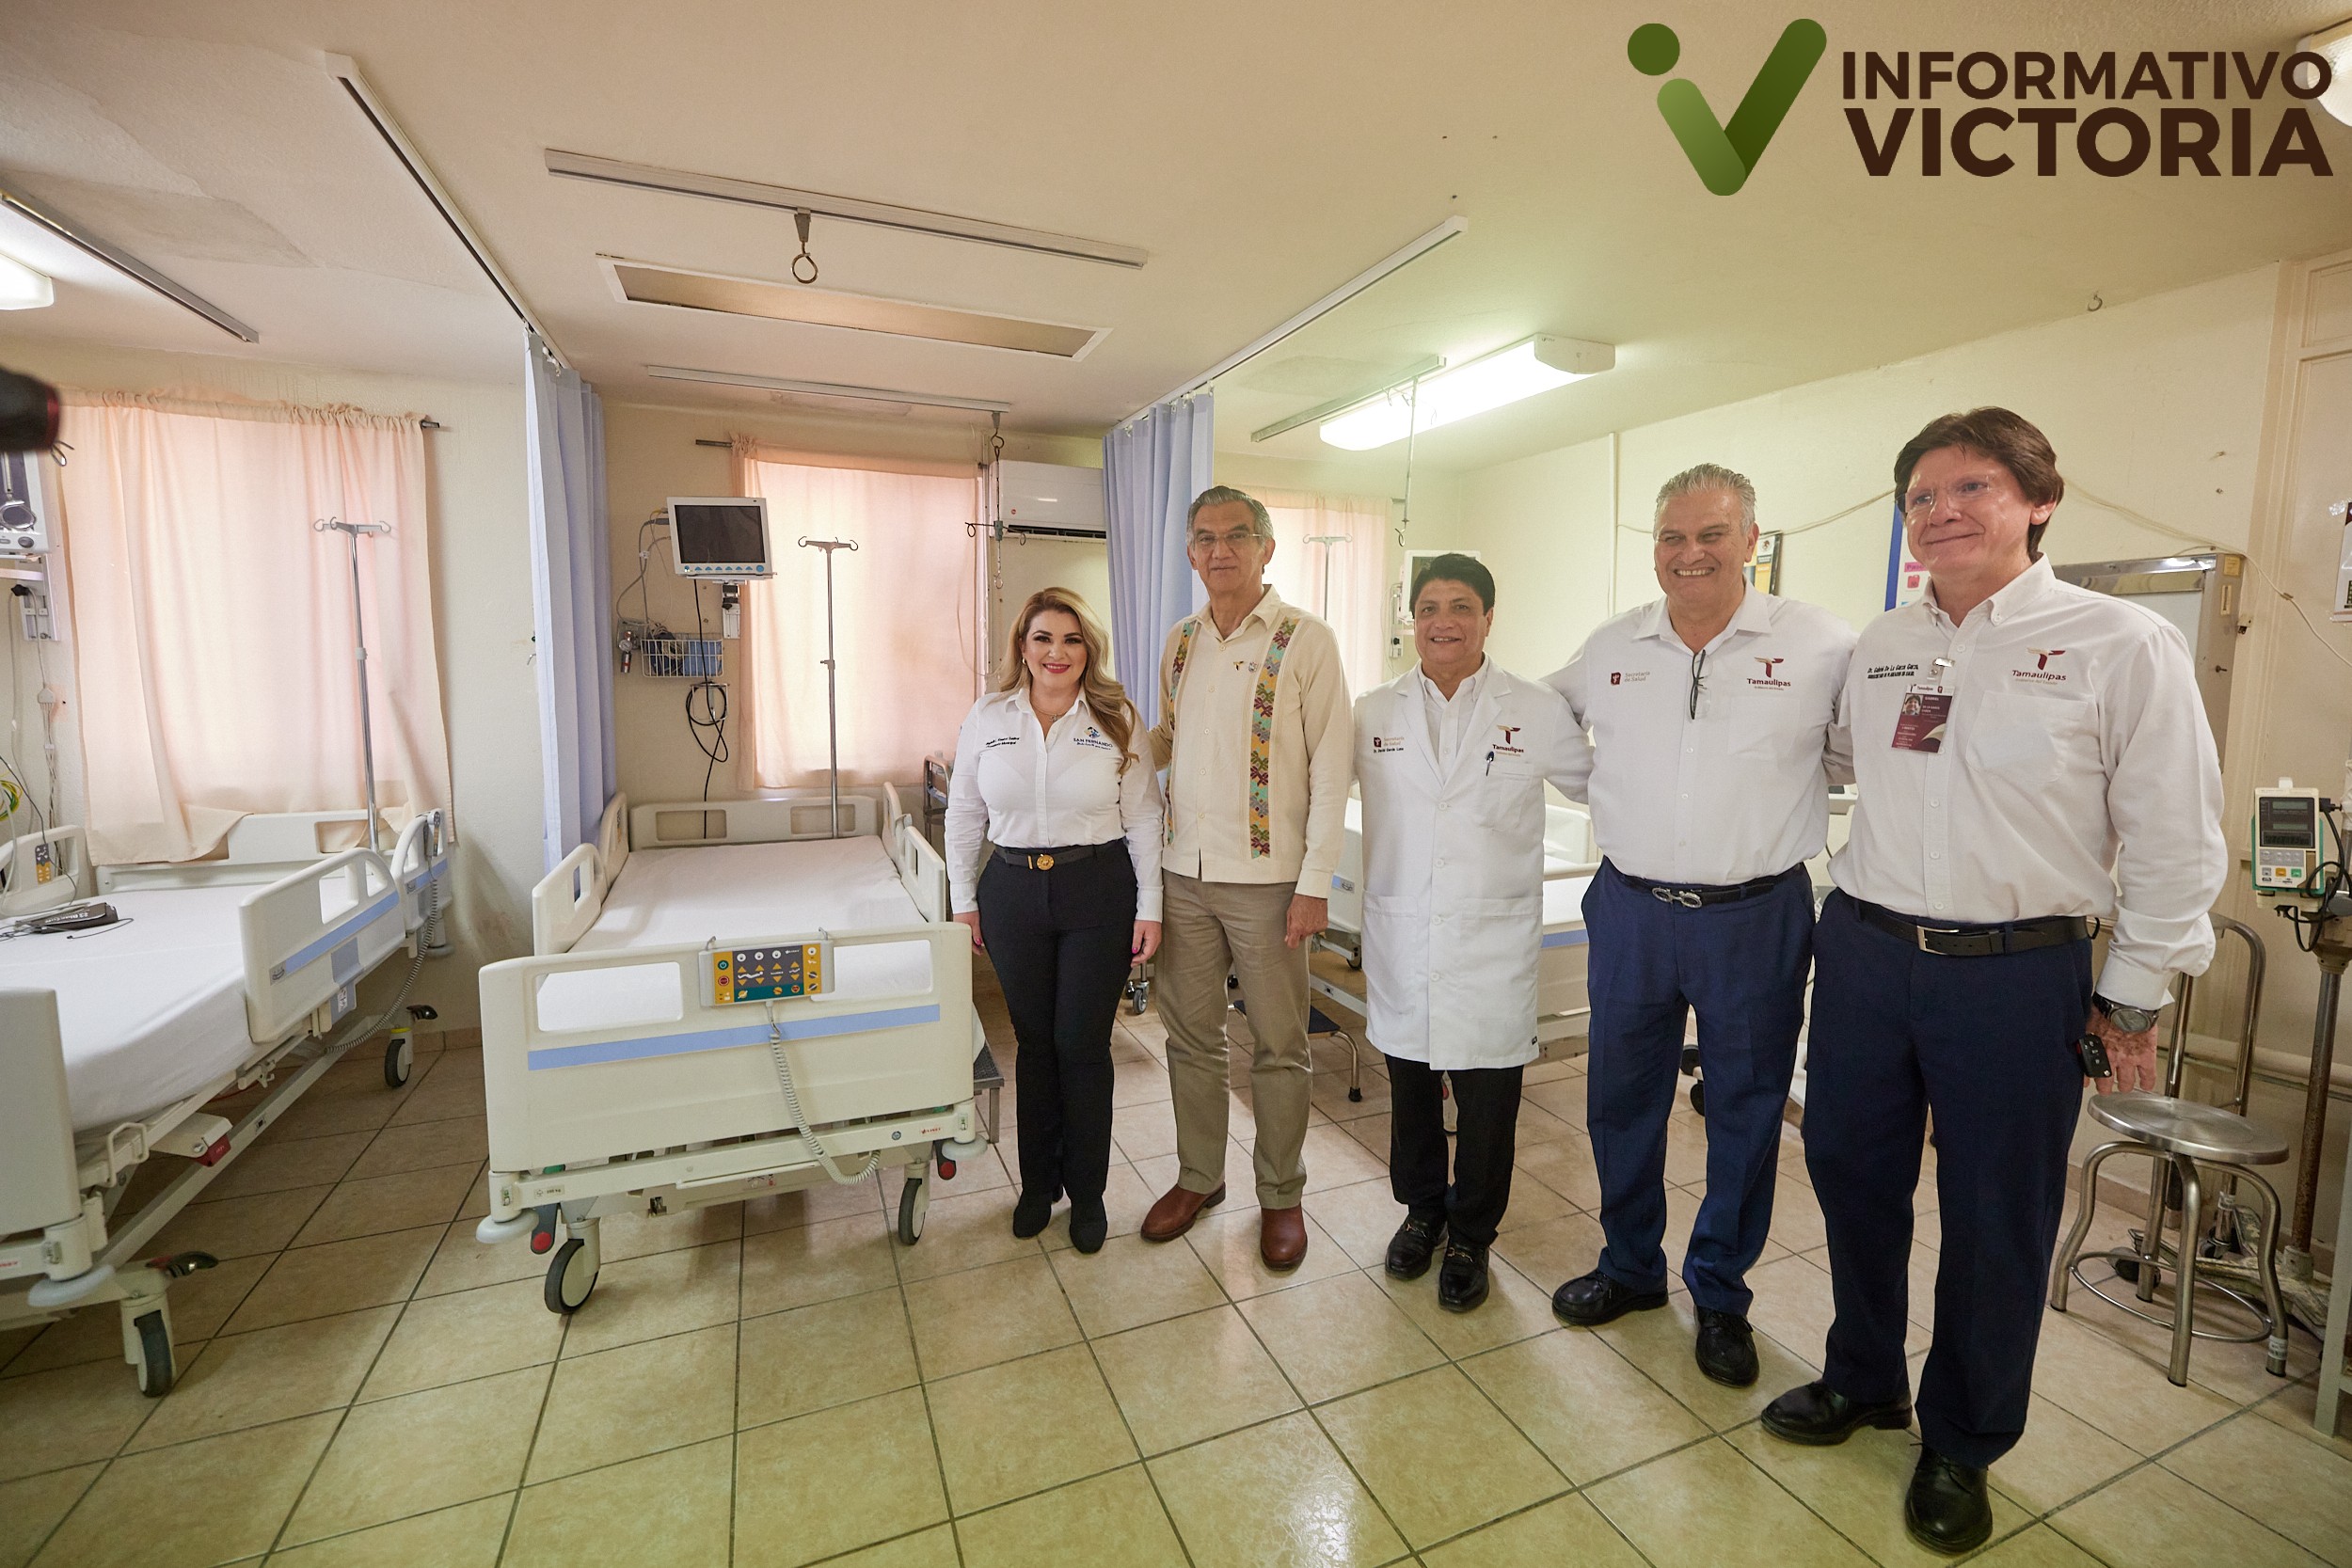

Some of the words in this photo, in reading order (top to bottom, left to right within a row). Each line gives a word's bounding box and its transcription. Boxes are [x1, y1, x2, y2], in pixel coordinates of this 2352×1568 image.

[2012, 670, 2067, 681] Tamaulipas
[1747, 678, 1791, 688] Tamaulipas
[1085, 738, 1113, 748] FERNANDO
[1492, 743, 1524, 753] Tamaulipas
